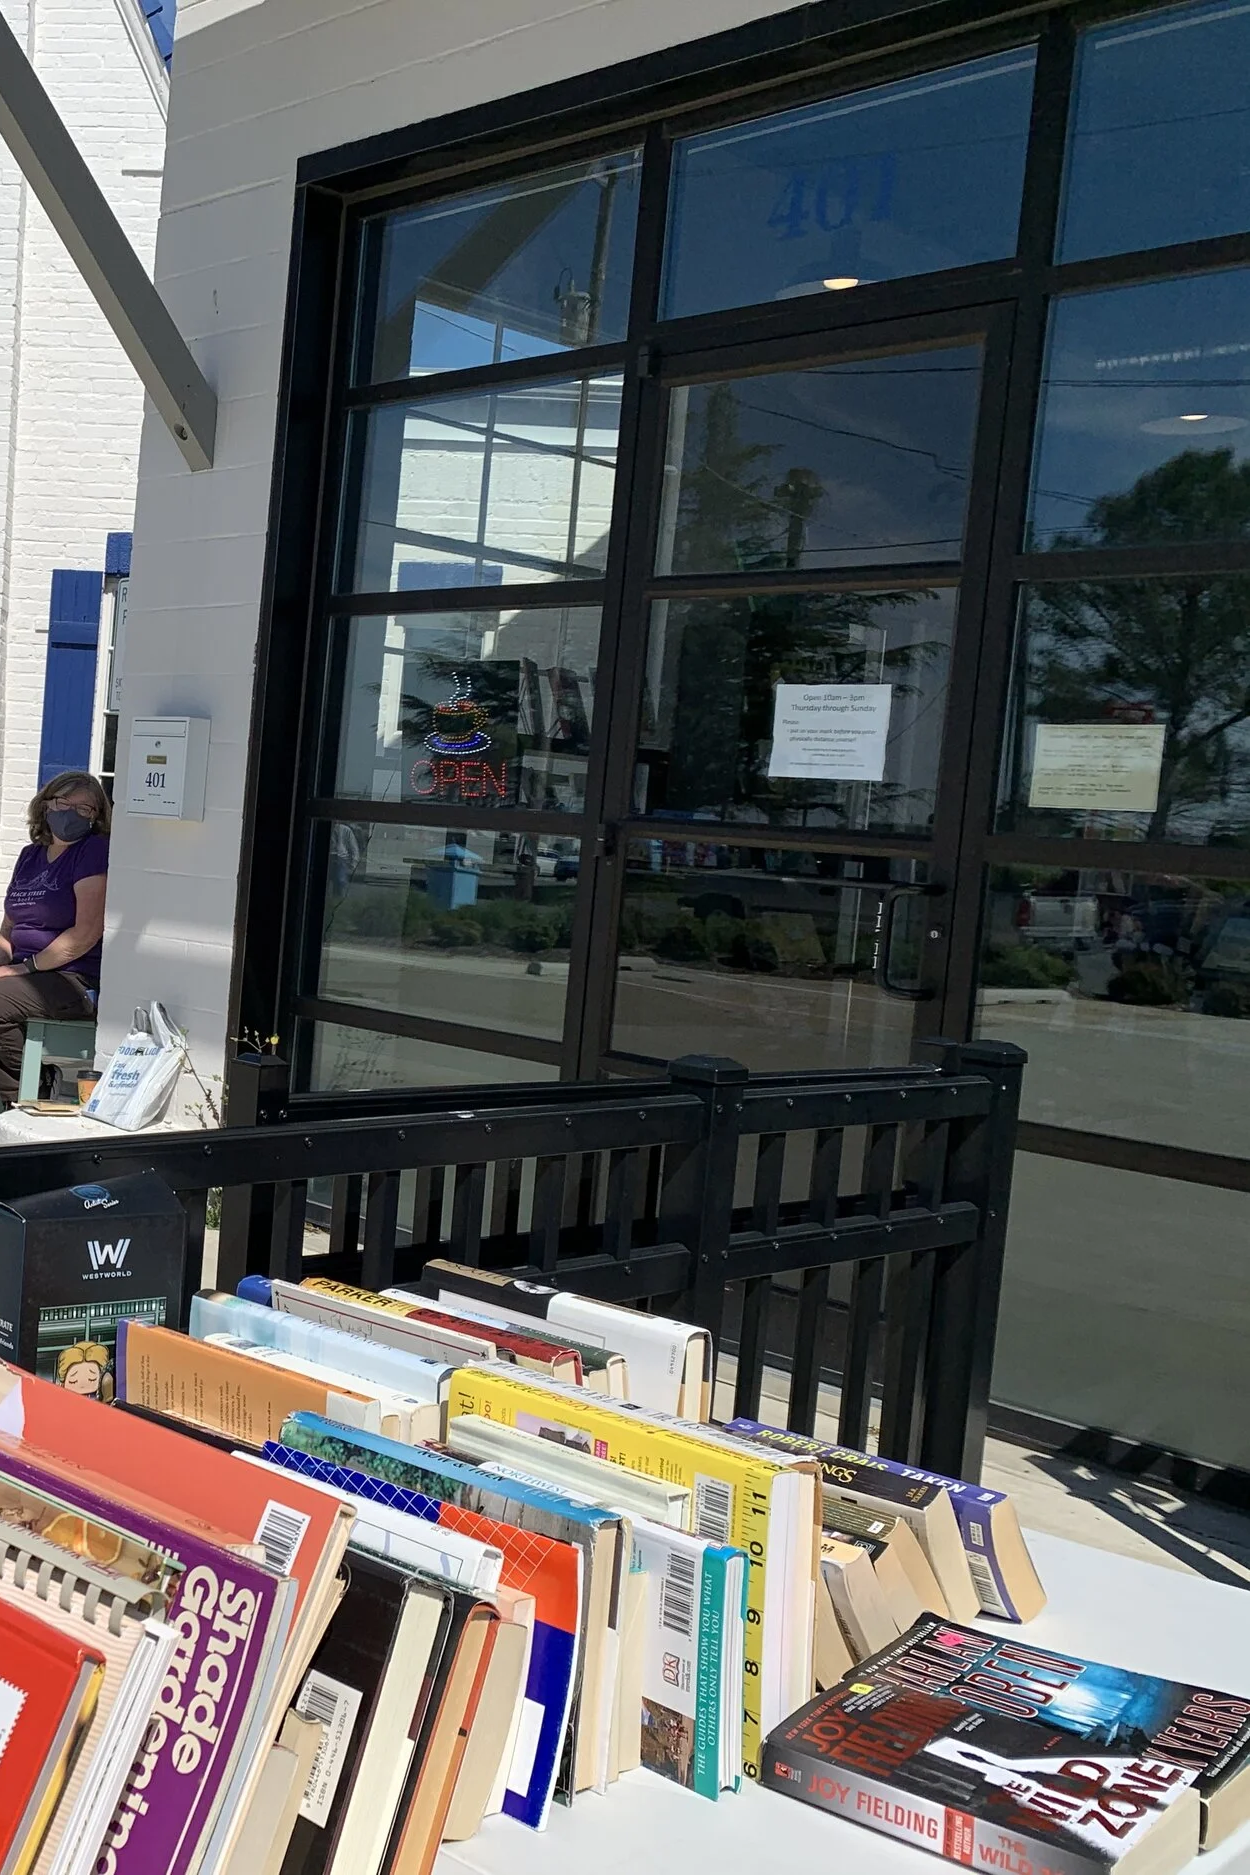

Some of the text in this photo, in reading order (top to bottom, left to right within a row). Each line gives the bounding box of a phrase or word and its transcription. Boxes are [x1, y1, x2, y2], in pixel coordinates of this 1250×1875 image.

[791, 704, 877, 713] Thursday through Sunday
[803, 693, 822, 702] Open
[145, 772, 166, 788] 401
[411, 760, 507, 798] OPEN
[111, 1070, 141, 1081] fresh
[82, 1271, 132, 1280] WESTWORLD
[312, 1279, 396, 1308] PARKER
[757, 1429, 968, 1494] ROBERT CRAIS TAKEN
[820, 1463, 857, 1484] NGS
[750, 1541, 764, 1568] 10
[747, 1608, 761, 1625] 9
[866, 1622, 937, 1673] NEW YORK TIMES BESTSELLER
[172, 1580, 255, 1774] Shade
[662, 1655, 679, 1683] DK
[697, 1571, 713, 1775] THE GUIDES THAT SHOW YOU WHAT
[707, 1611, 720, 1746] OTHERS ONLY TELL YOU
[745, 1661, 759, 1676] 8
[743, 1710, 758, 1726] 7
[785, 1704, 828, 1740] NEW YORK TIMES
[802, 1708, 859, 1753] JOY
[1151, 1694, 1250, 1757] YEARS
[743, 1763, 757, 1778] 6
[807, 1774, 850, 1804] JOY
[857, 1790, 938, 1839] FIELDING
[1077, 1759, 1185, 1840] ZONE
[953, 1815, 965, 1860] BESTSELLING
[978, 1844, 1033, 1875] WILD
